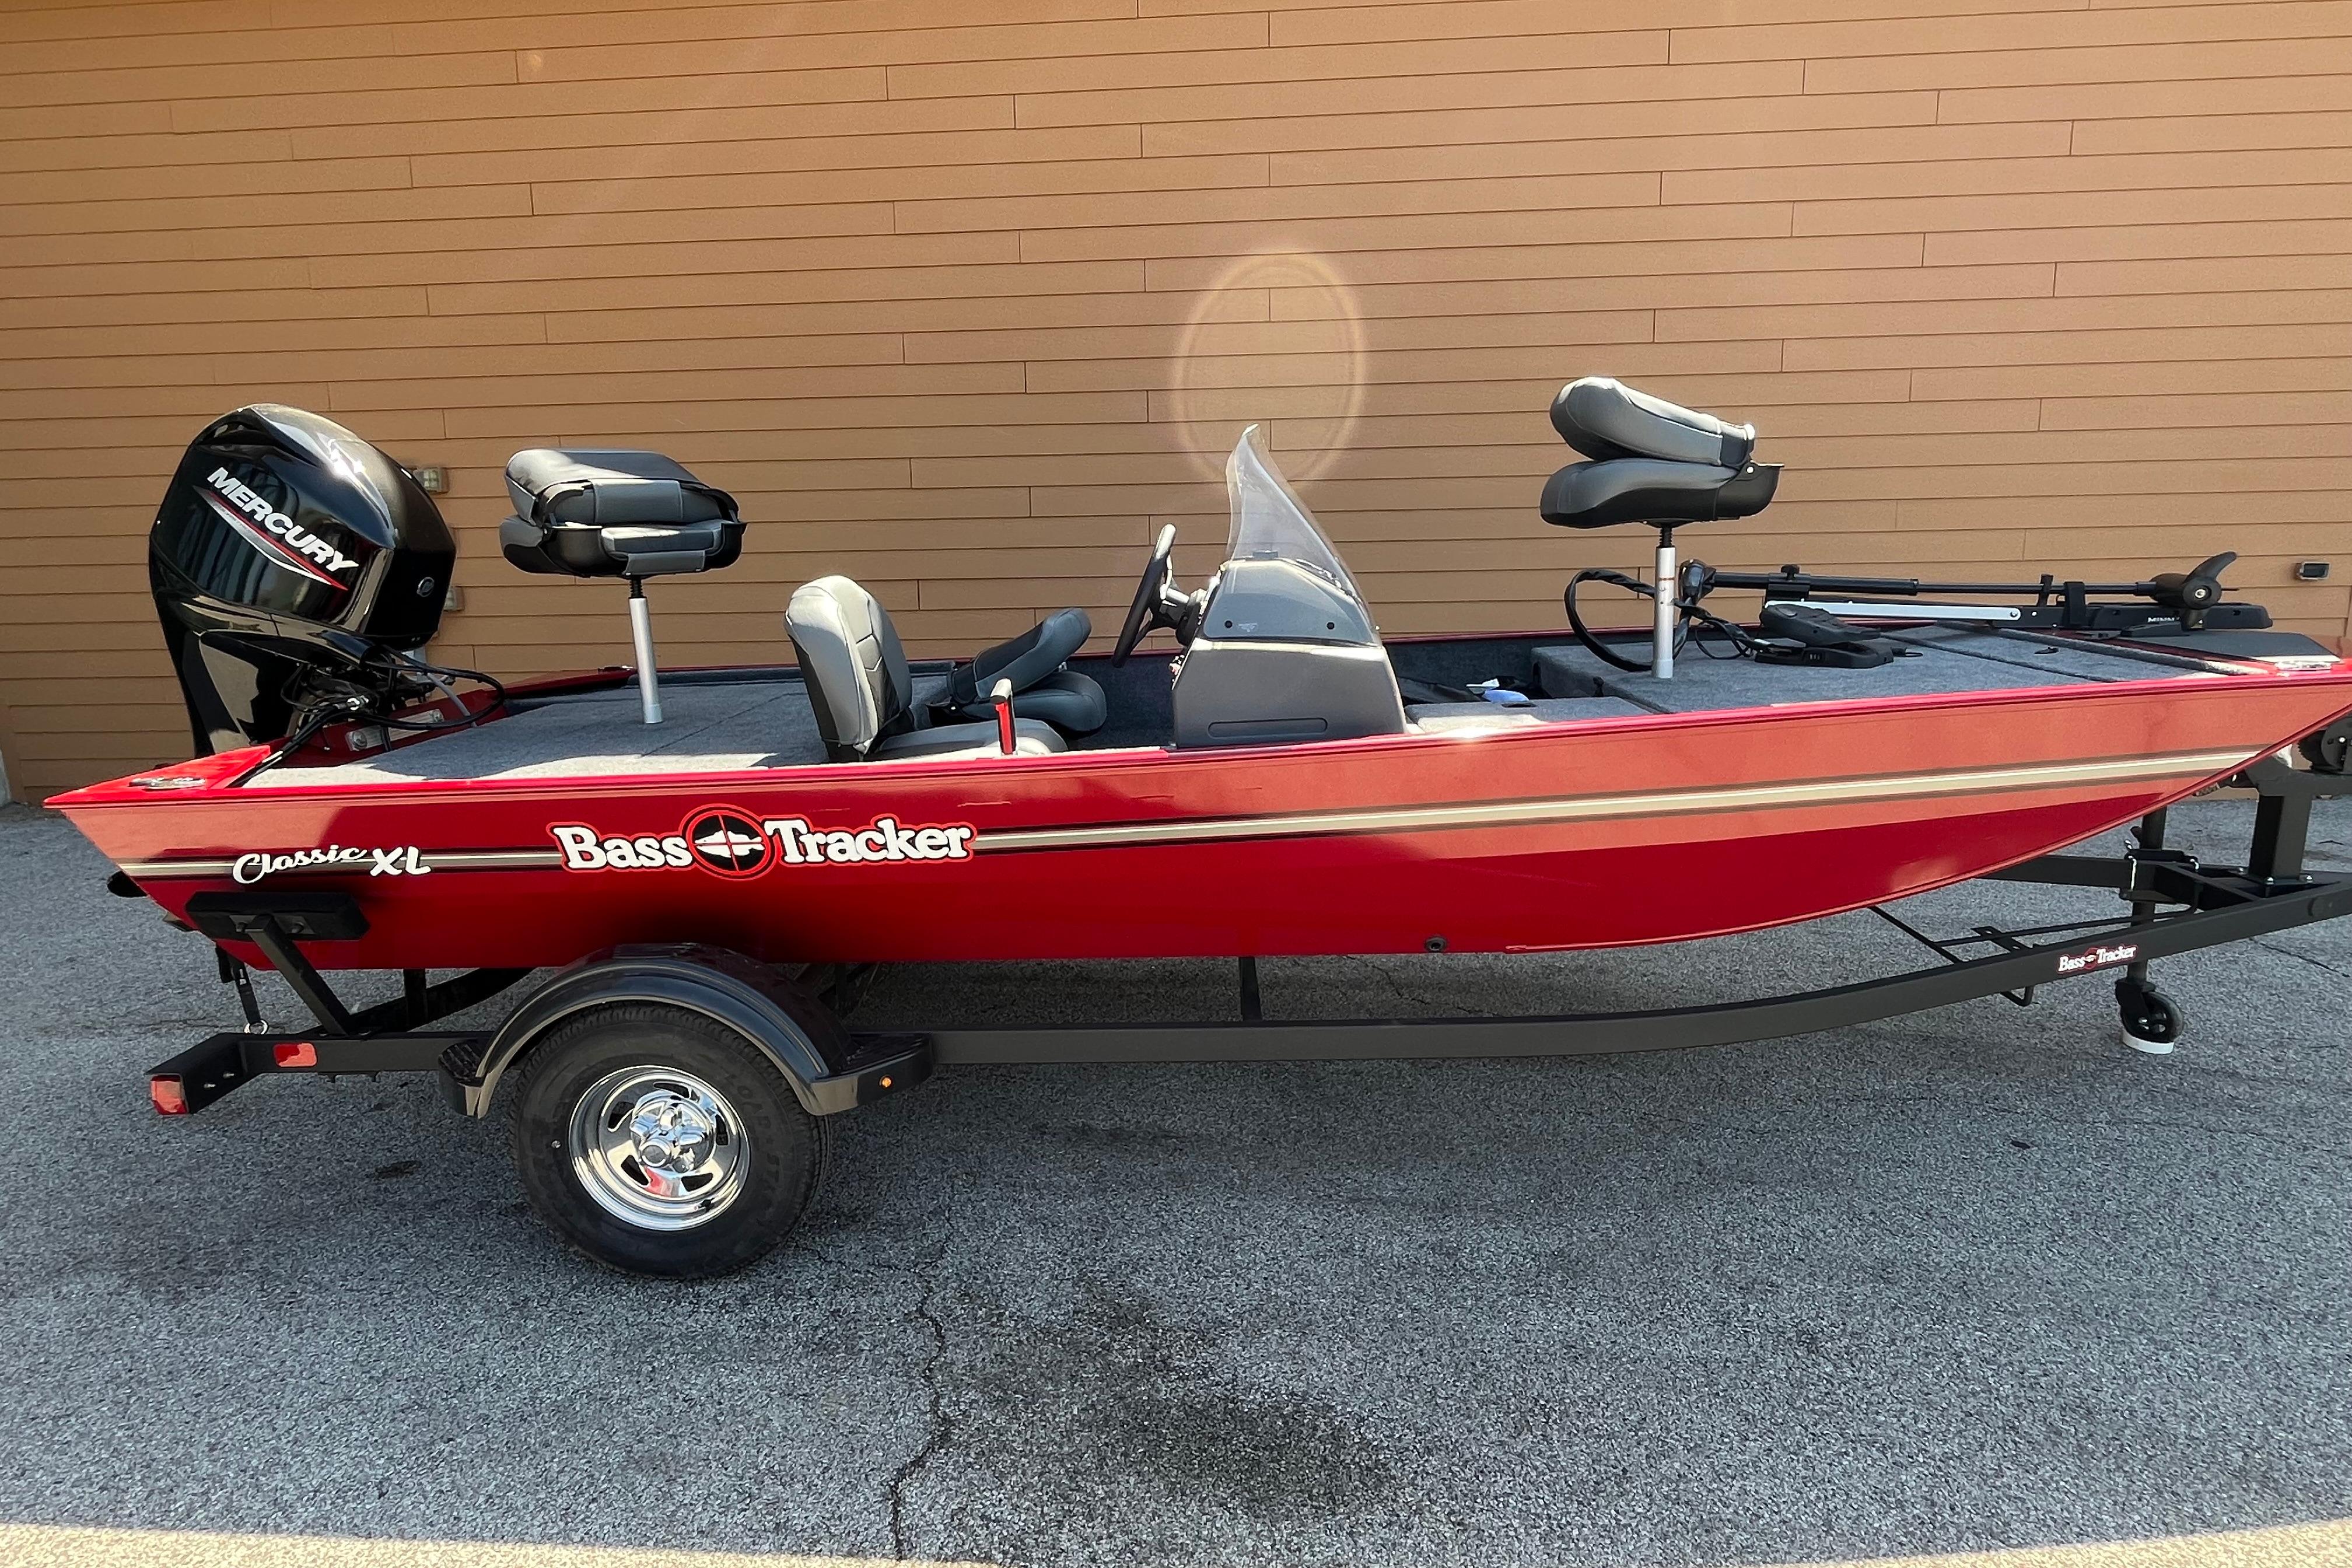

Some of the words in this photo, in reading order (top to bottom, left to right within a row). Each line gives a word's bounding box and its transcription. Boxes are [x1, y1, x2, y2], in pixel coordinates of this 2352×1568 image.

[207, 467, 359, 572] MERCURY
[233, 845, 368, 884] Classic
[370, 846, 431, 876] XL
[554, 827, 693, 868] Bass
[764, 818, 971, 862] Tracker
[2059, 956, 2086, 972] Bass
[2096, 946, 2136, 964] Tracker
